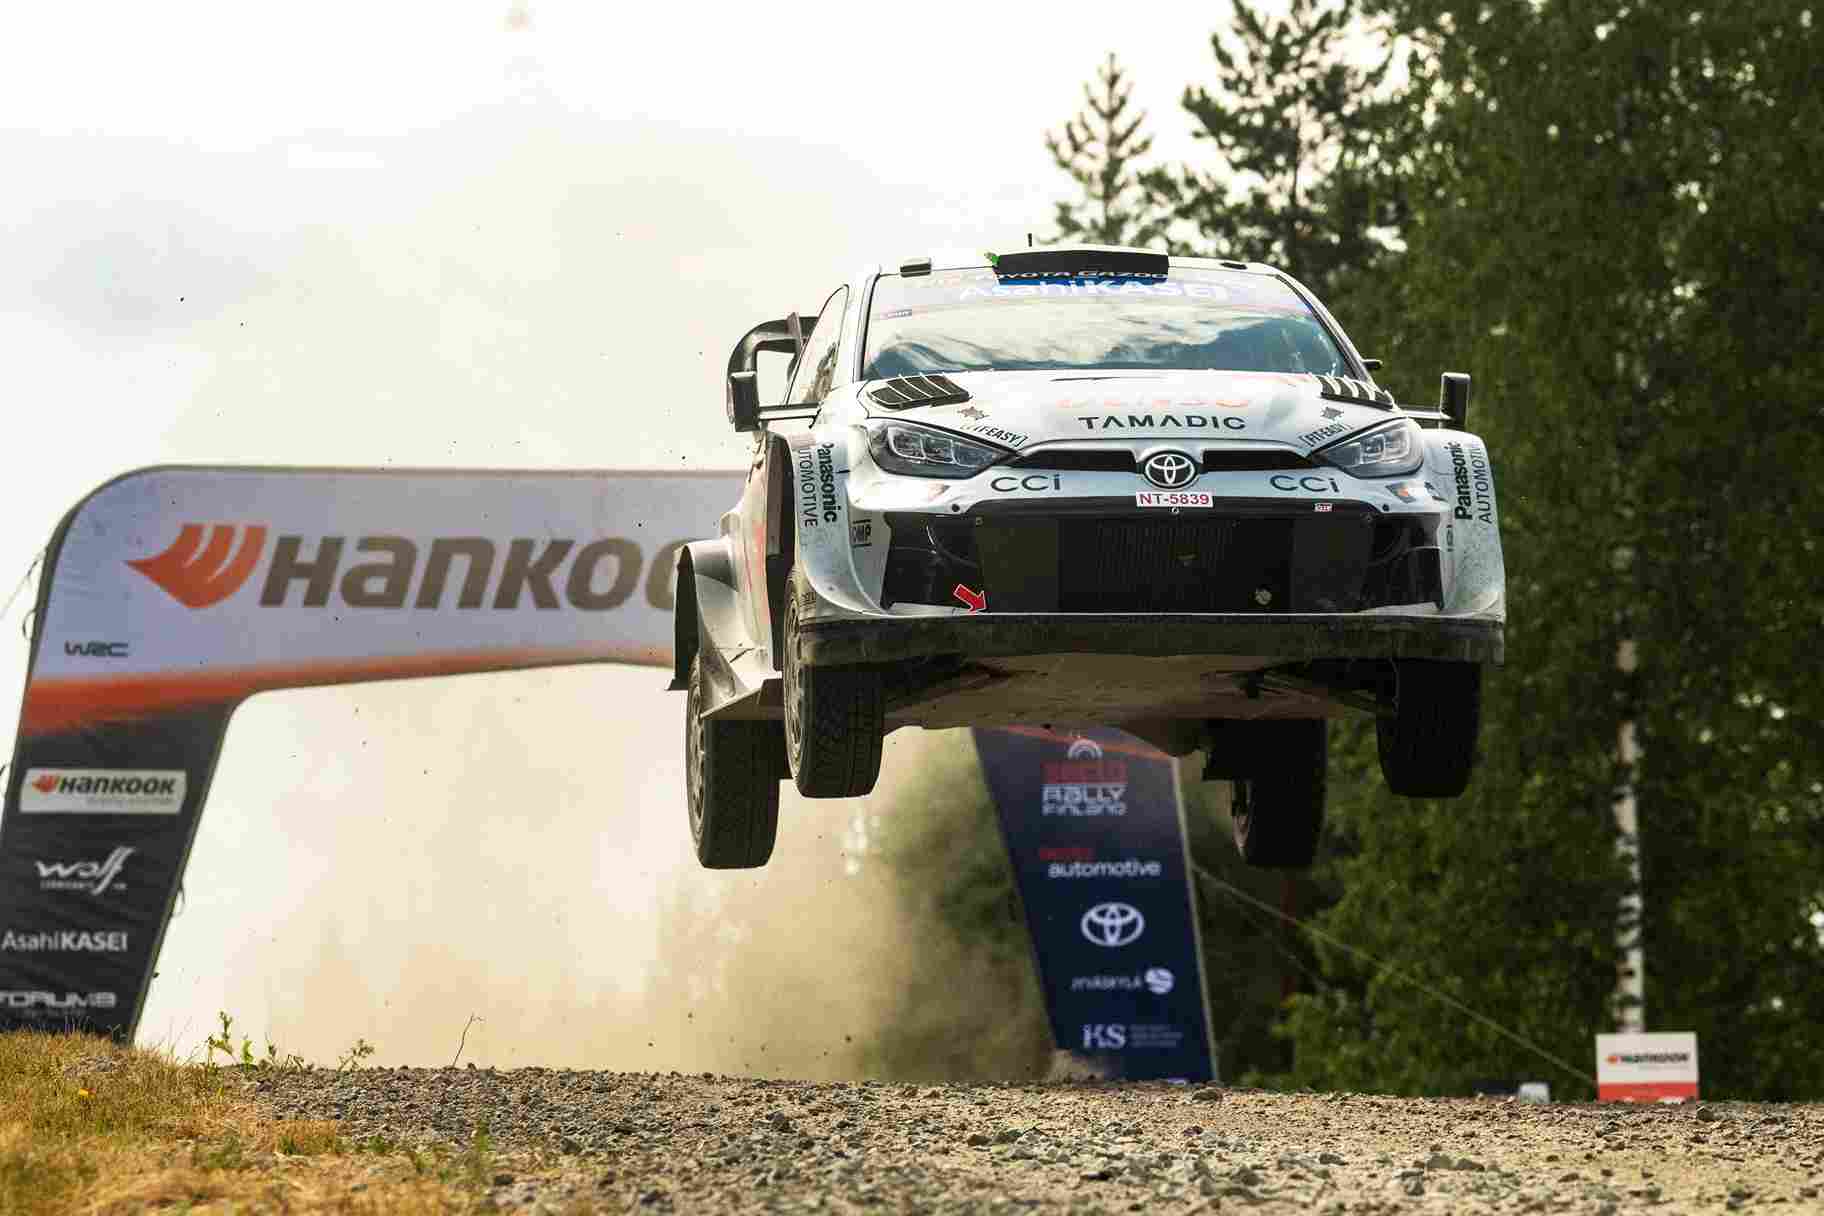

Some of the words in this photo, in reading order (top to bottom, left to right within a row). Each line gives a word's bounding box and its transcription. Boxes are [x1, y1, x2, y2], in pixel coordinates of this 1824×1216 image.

[1077, 414, 1246, 430] TAMADIC
[798, 446, 818, 528] UTOMOTIVE
[1443, 441, 1473, 520] Panasonic
[1471, 446, 1493, 525] AUTOMOTI
[1138, 493, 1210, 505] NT-5839
[1048, 857, 1162, 878] automotive
[1, 930, 128, 951] AsahiKASEI
